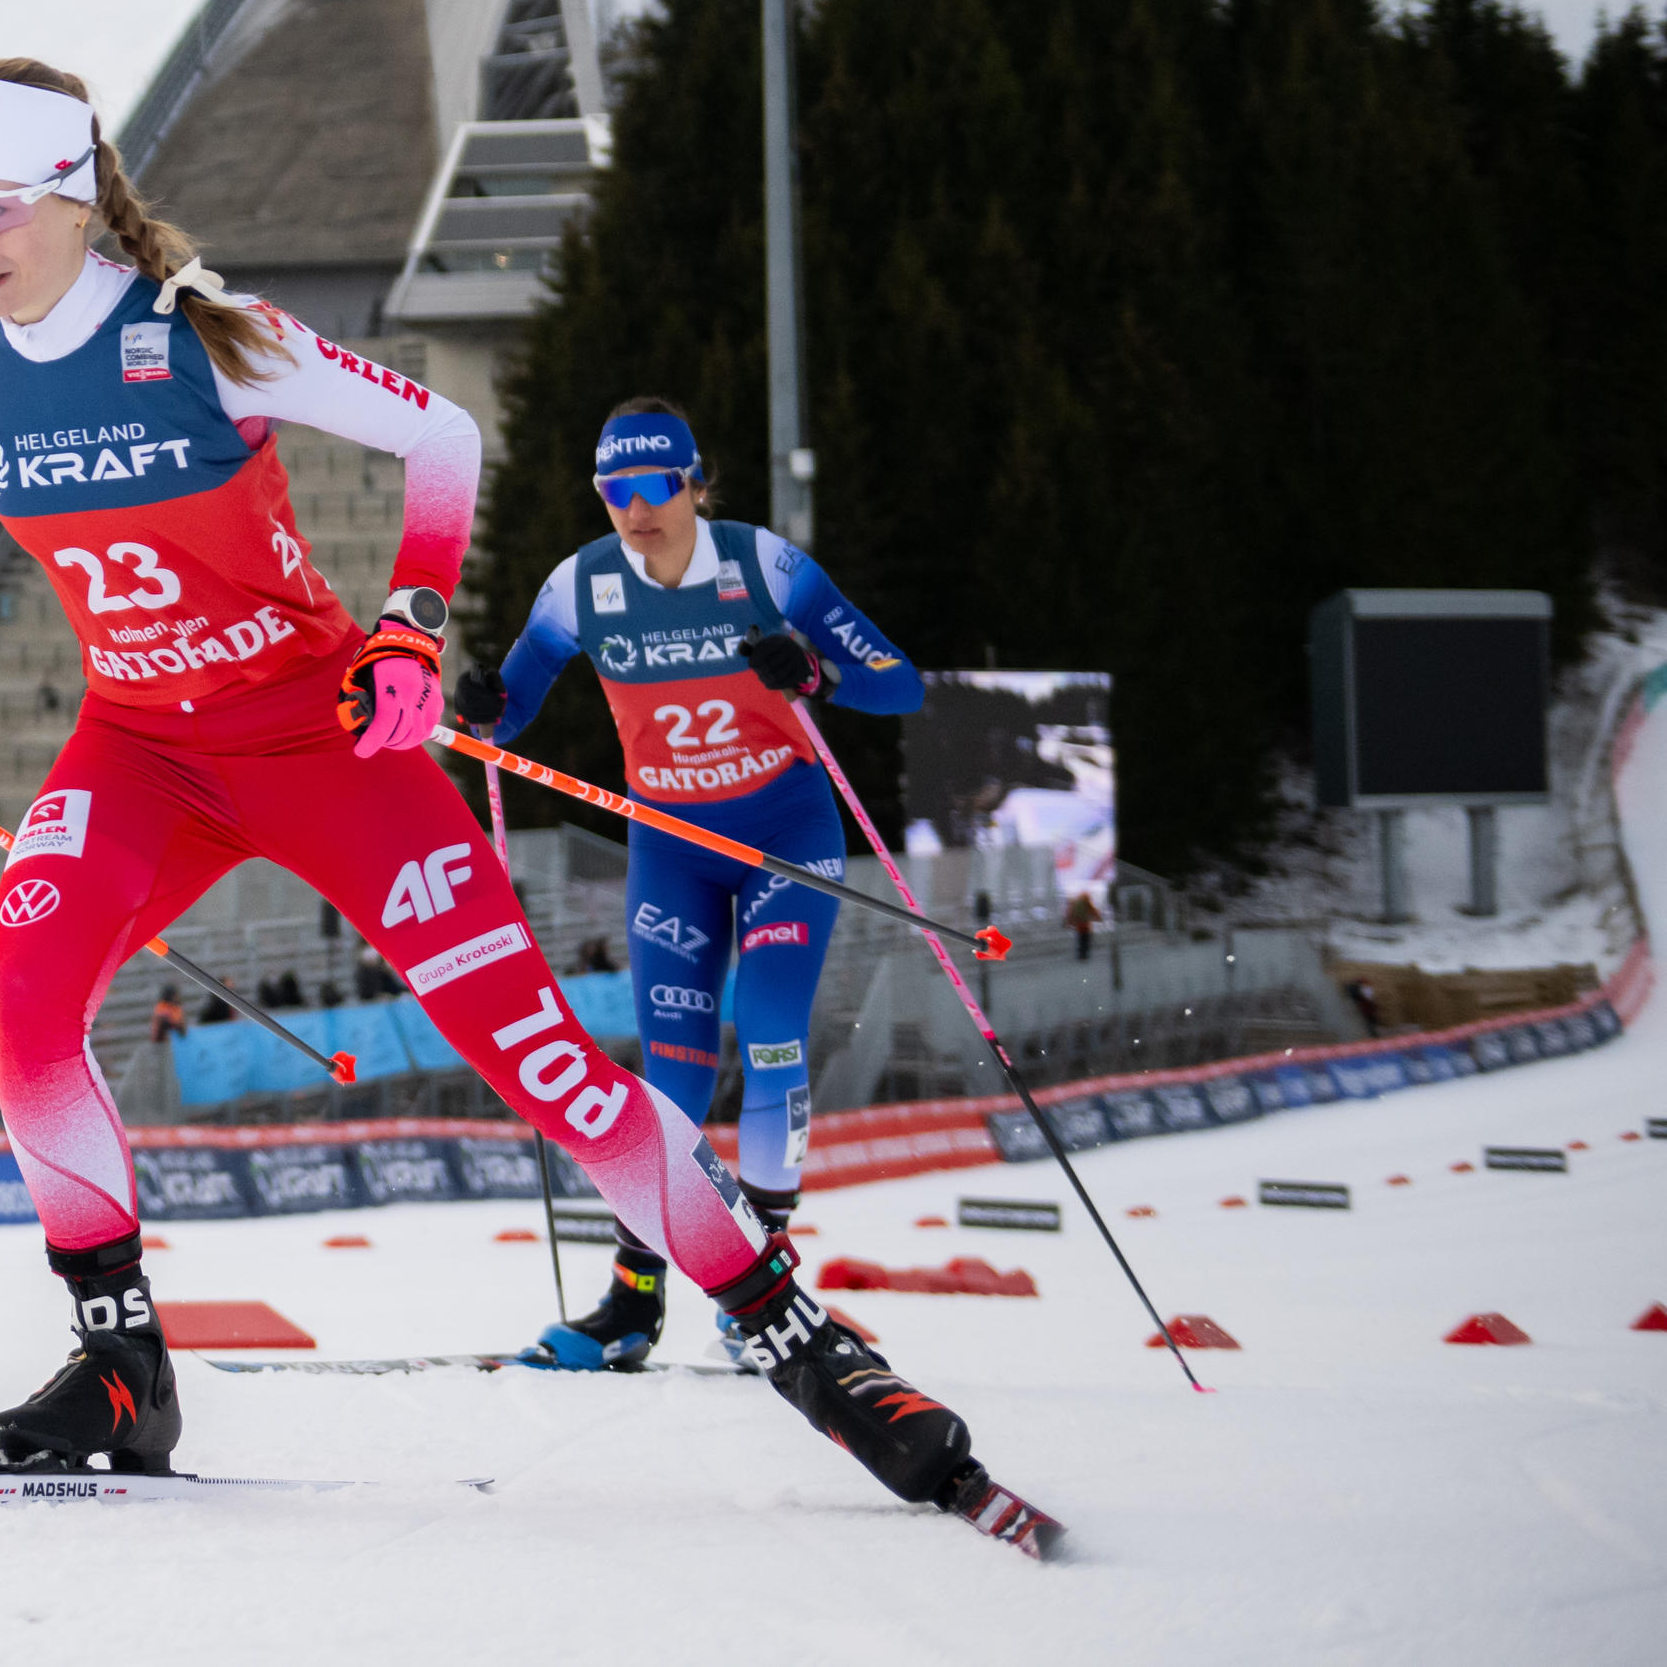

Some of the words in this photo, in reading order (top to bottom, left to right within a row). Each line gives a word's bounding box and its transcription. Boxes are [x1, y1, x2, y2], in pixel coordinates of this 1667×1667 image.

[315, 336, 430, 411] ORLEN
[15, 423, 146, 451] HELGELAND
[18, 438, 191, 488] KRAFT
[53, 542, 181, 615] 23
[642, 623, 736, 644] HELGELAND
[653, 698, 741, 749] 22
[18, 826, 67, 842] ORLEN
[381, 842, 473, 929] 4F
[634, 902, 710, 949] EA7
[744, 924, 799, 948] enel
[417, 959, 455, 985] Grupa
[454, 933, 514, 967] Krotoski
[653, 1008, 682, 1021] Audi
[492, 986, 629, 1139] POL
[22, 1482, 98, 1498] MADSHUS
